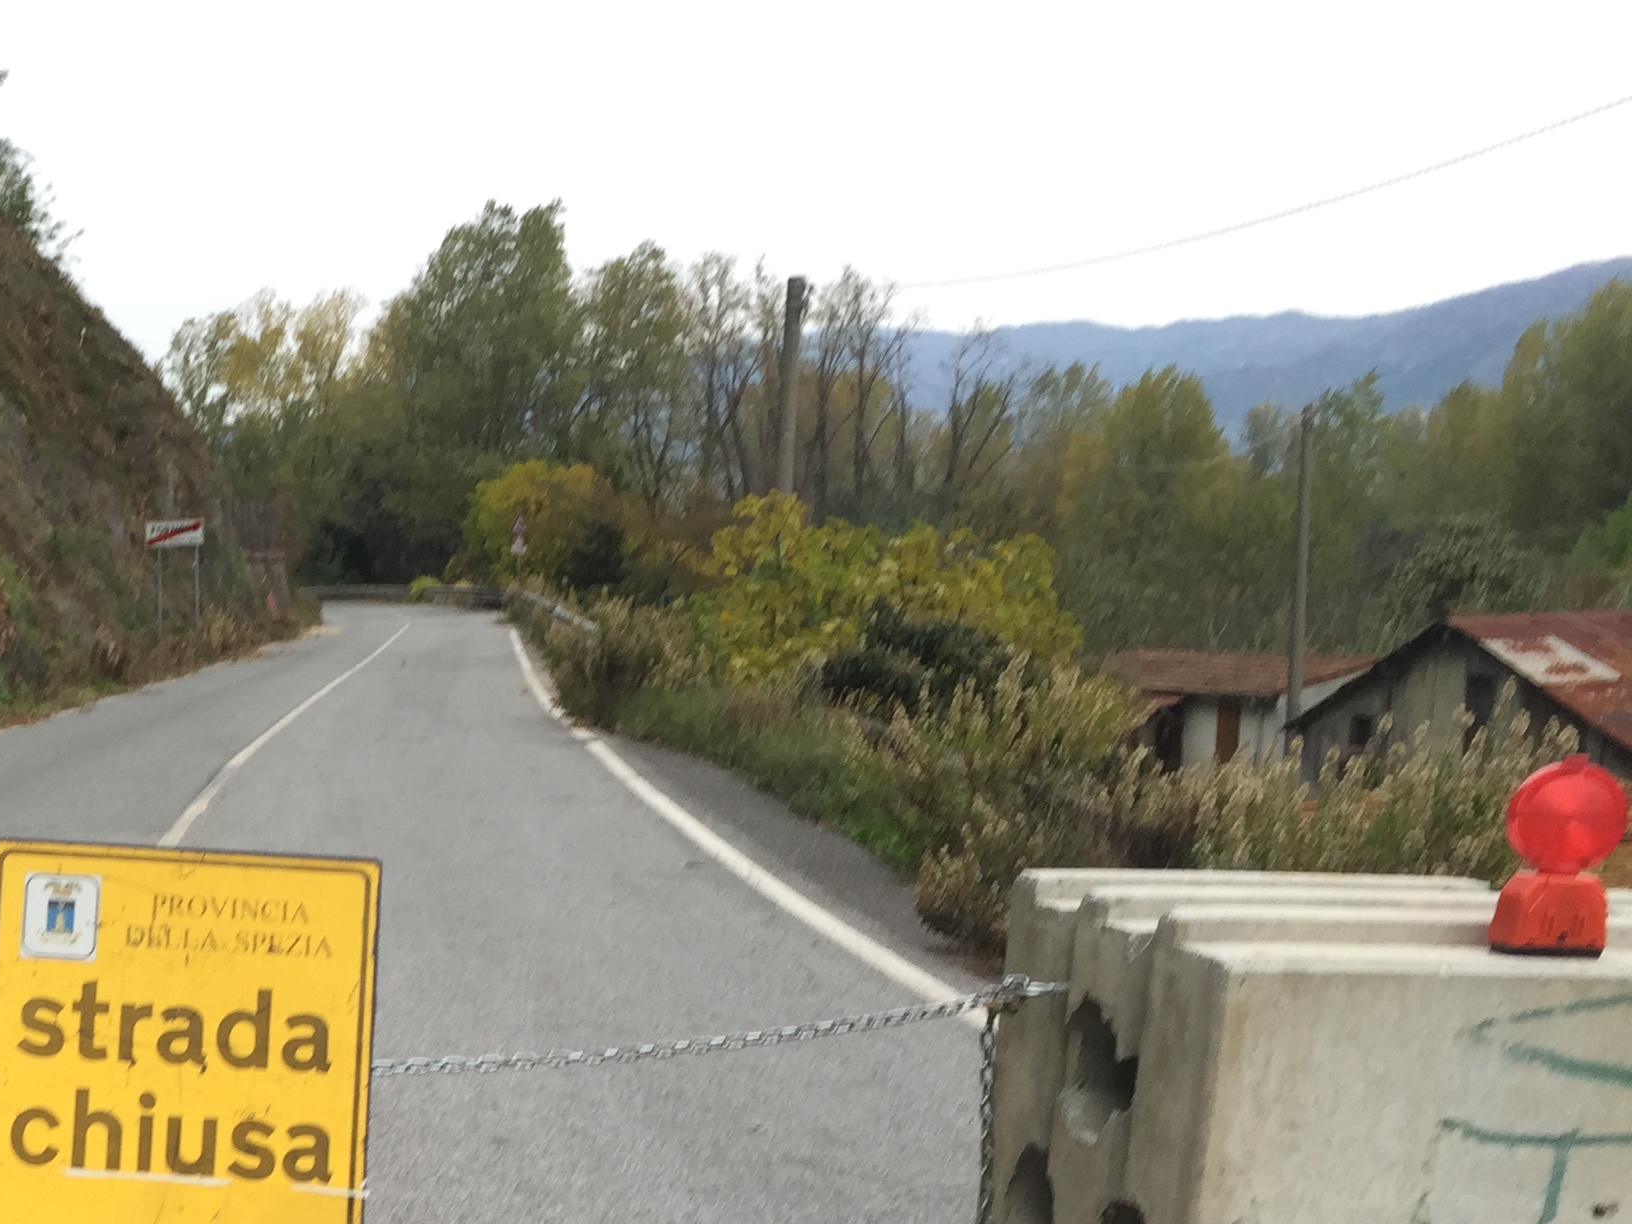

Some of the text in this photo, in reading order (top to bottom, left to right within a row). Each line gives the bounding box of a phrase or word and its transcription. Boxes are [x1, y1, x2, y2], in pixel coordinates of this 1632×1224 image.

[151, 892, 310, 925] PROVINCIA
[126, 924, 334, 959] DELLA SPEZIA
[16, 979, 333, 1074] strada
[10, 1088, 334, 1184] chiusa
